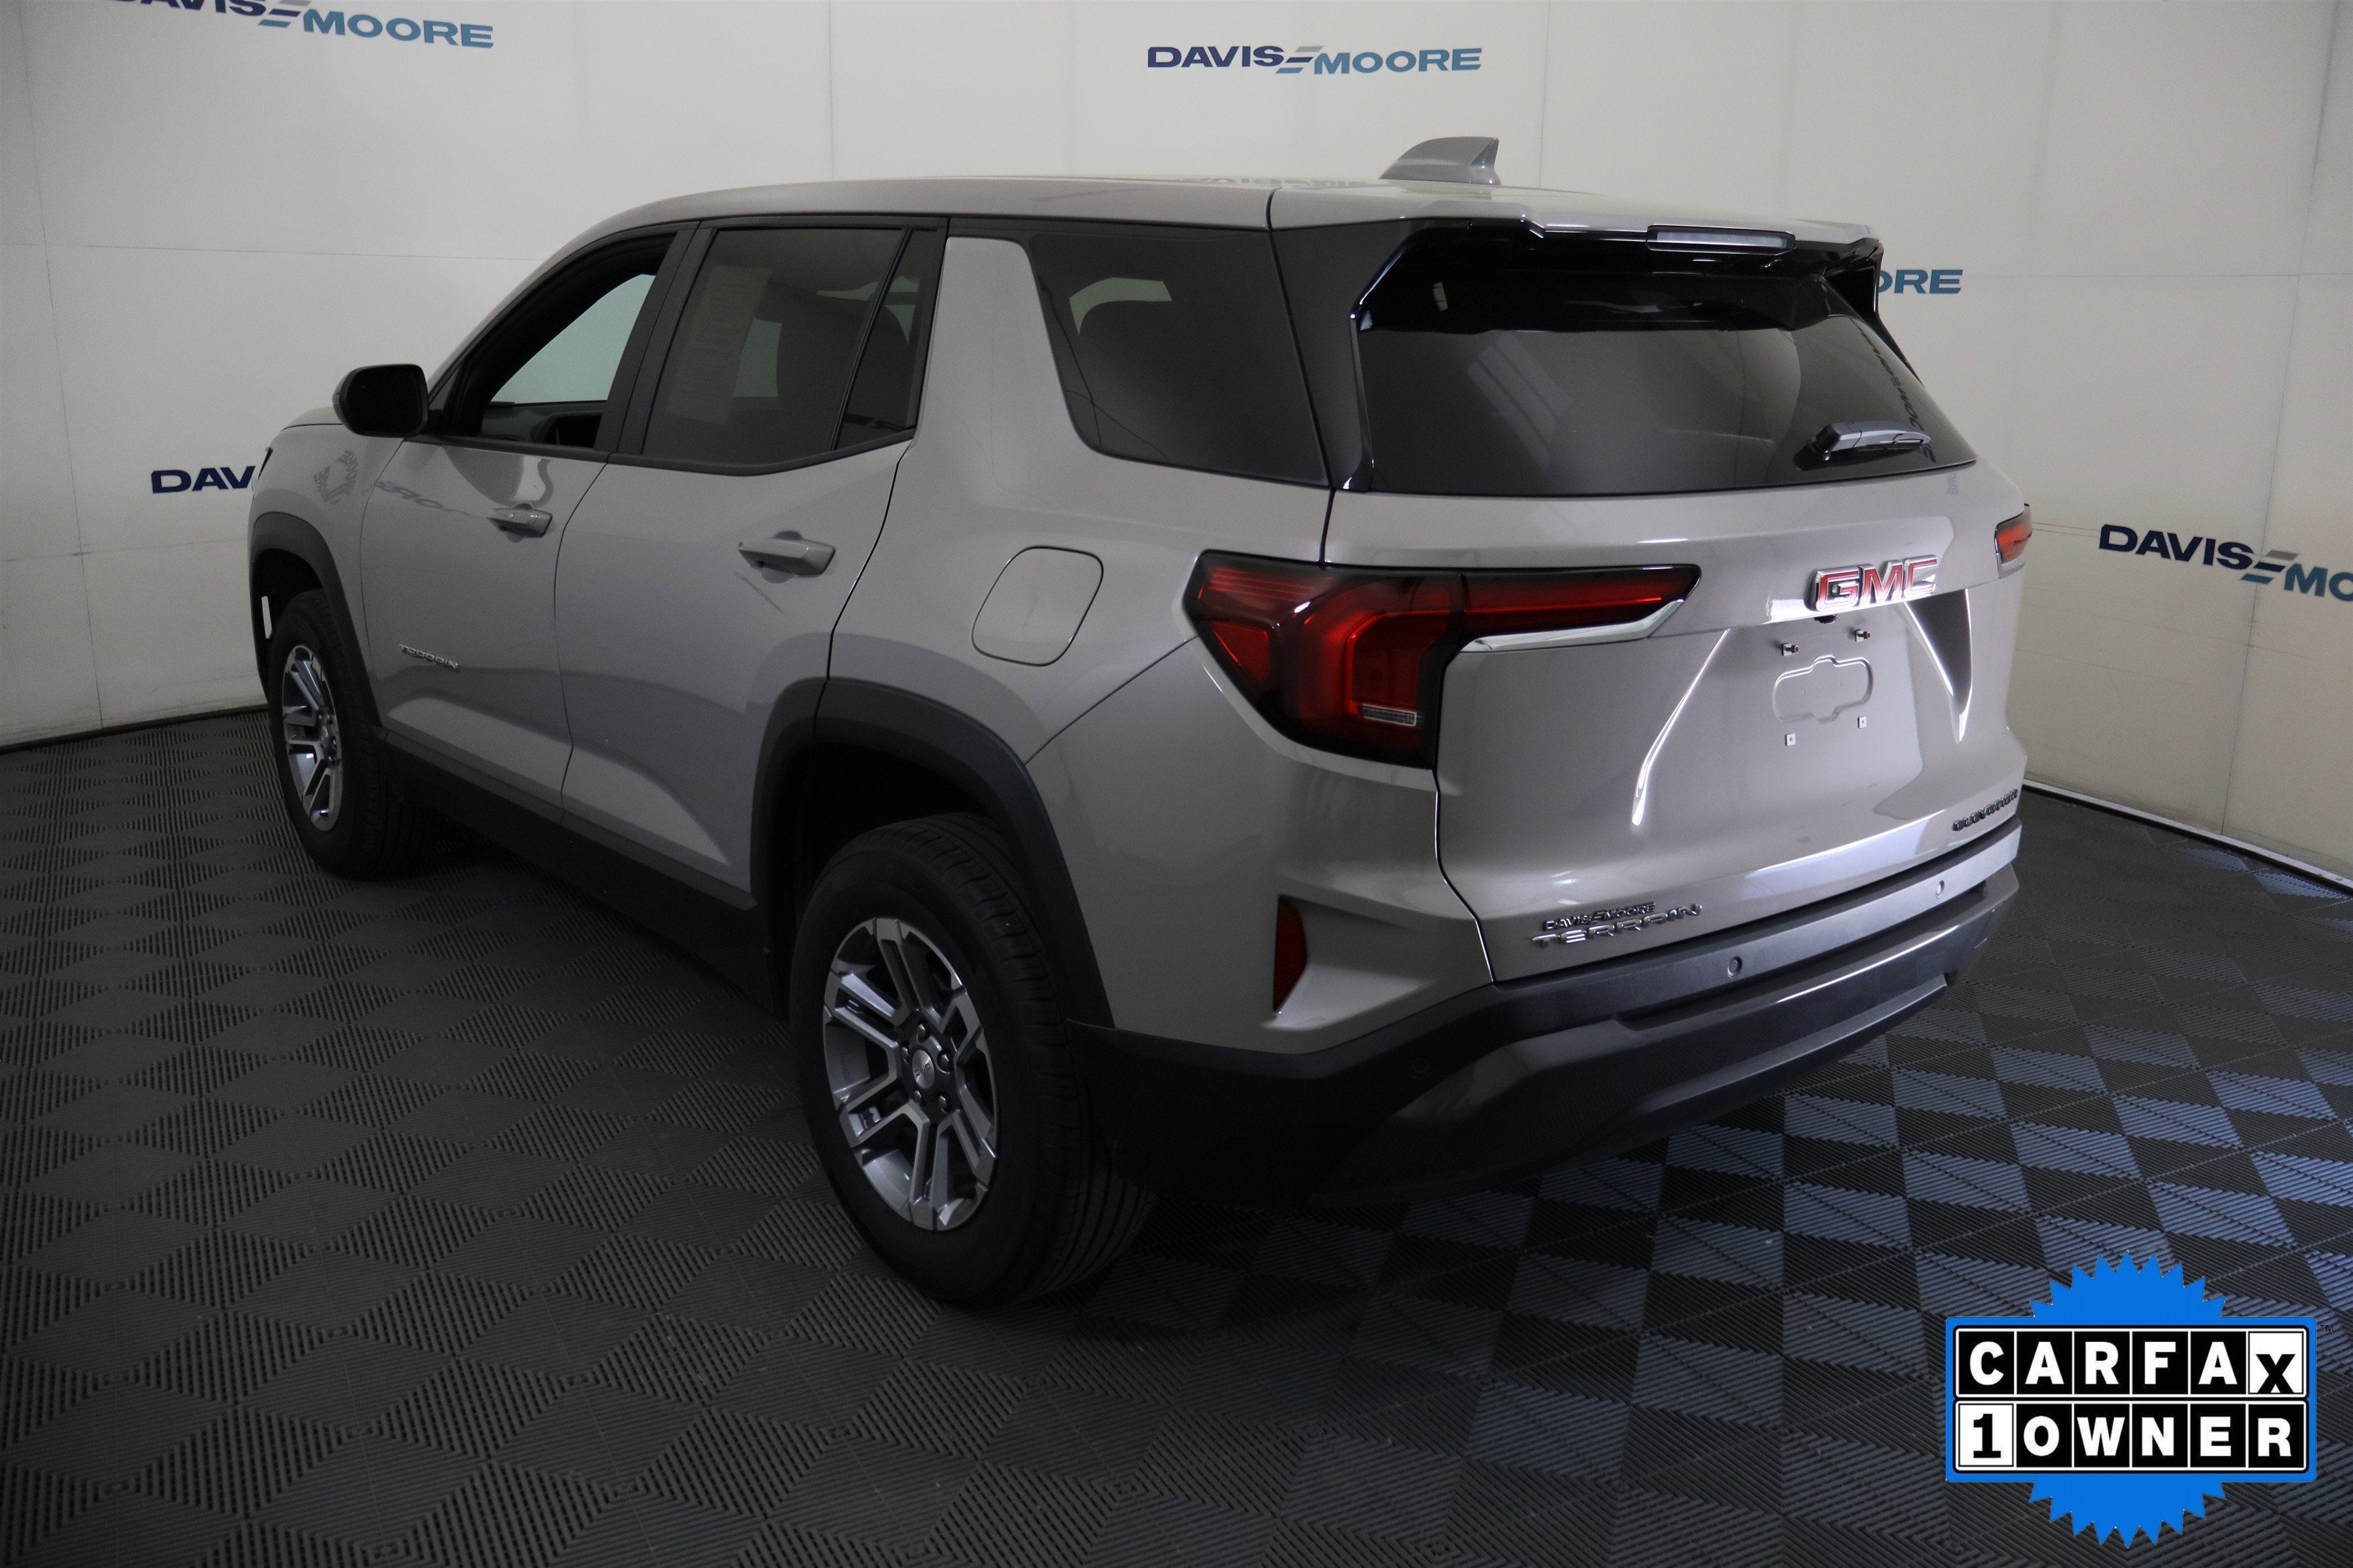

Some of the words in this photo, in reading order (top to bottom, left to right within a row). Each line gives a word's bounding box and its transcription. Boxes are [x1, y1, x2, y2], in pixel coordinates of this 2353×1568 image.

[303, 9, 494, 49] MOORE
[1148, 45, 1285, 68] DAVIS
[1313, 48, 1482, 75] MOORE
[151, 465, 256, 493] DAV
[2099, 524, 2255, 570] DAVIS
[1813, 554, 1938, 612] GMC
[1532, 903, 1703, 947] TERRAIN
